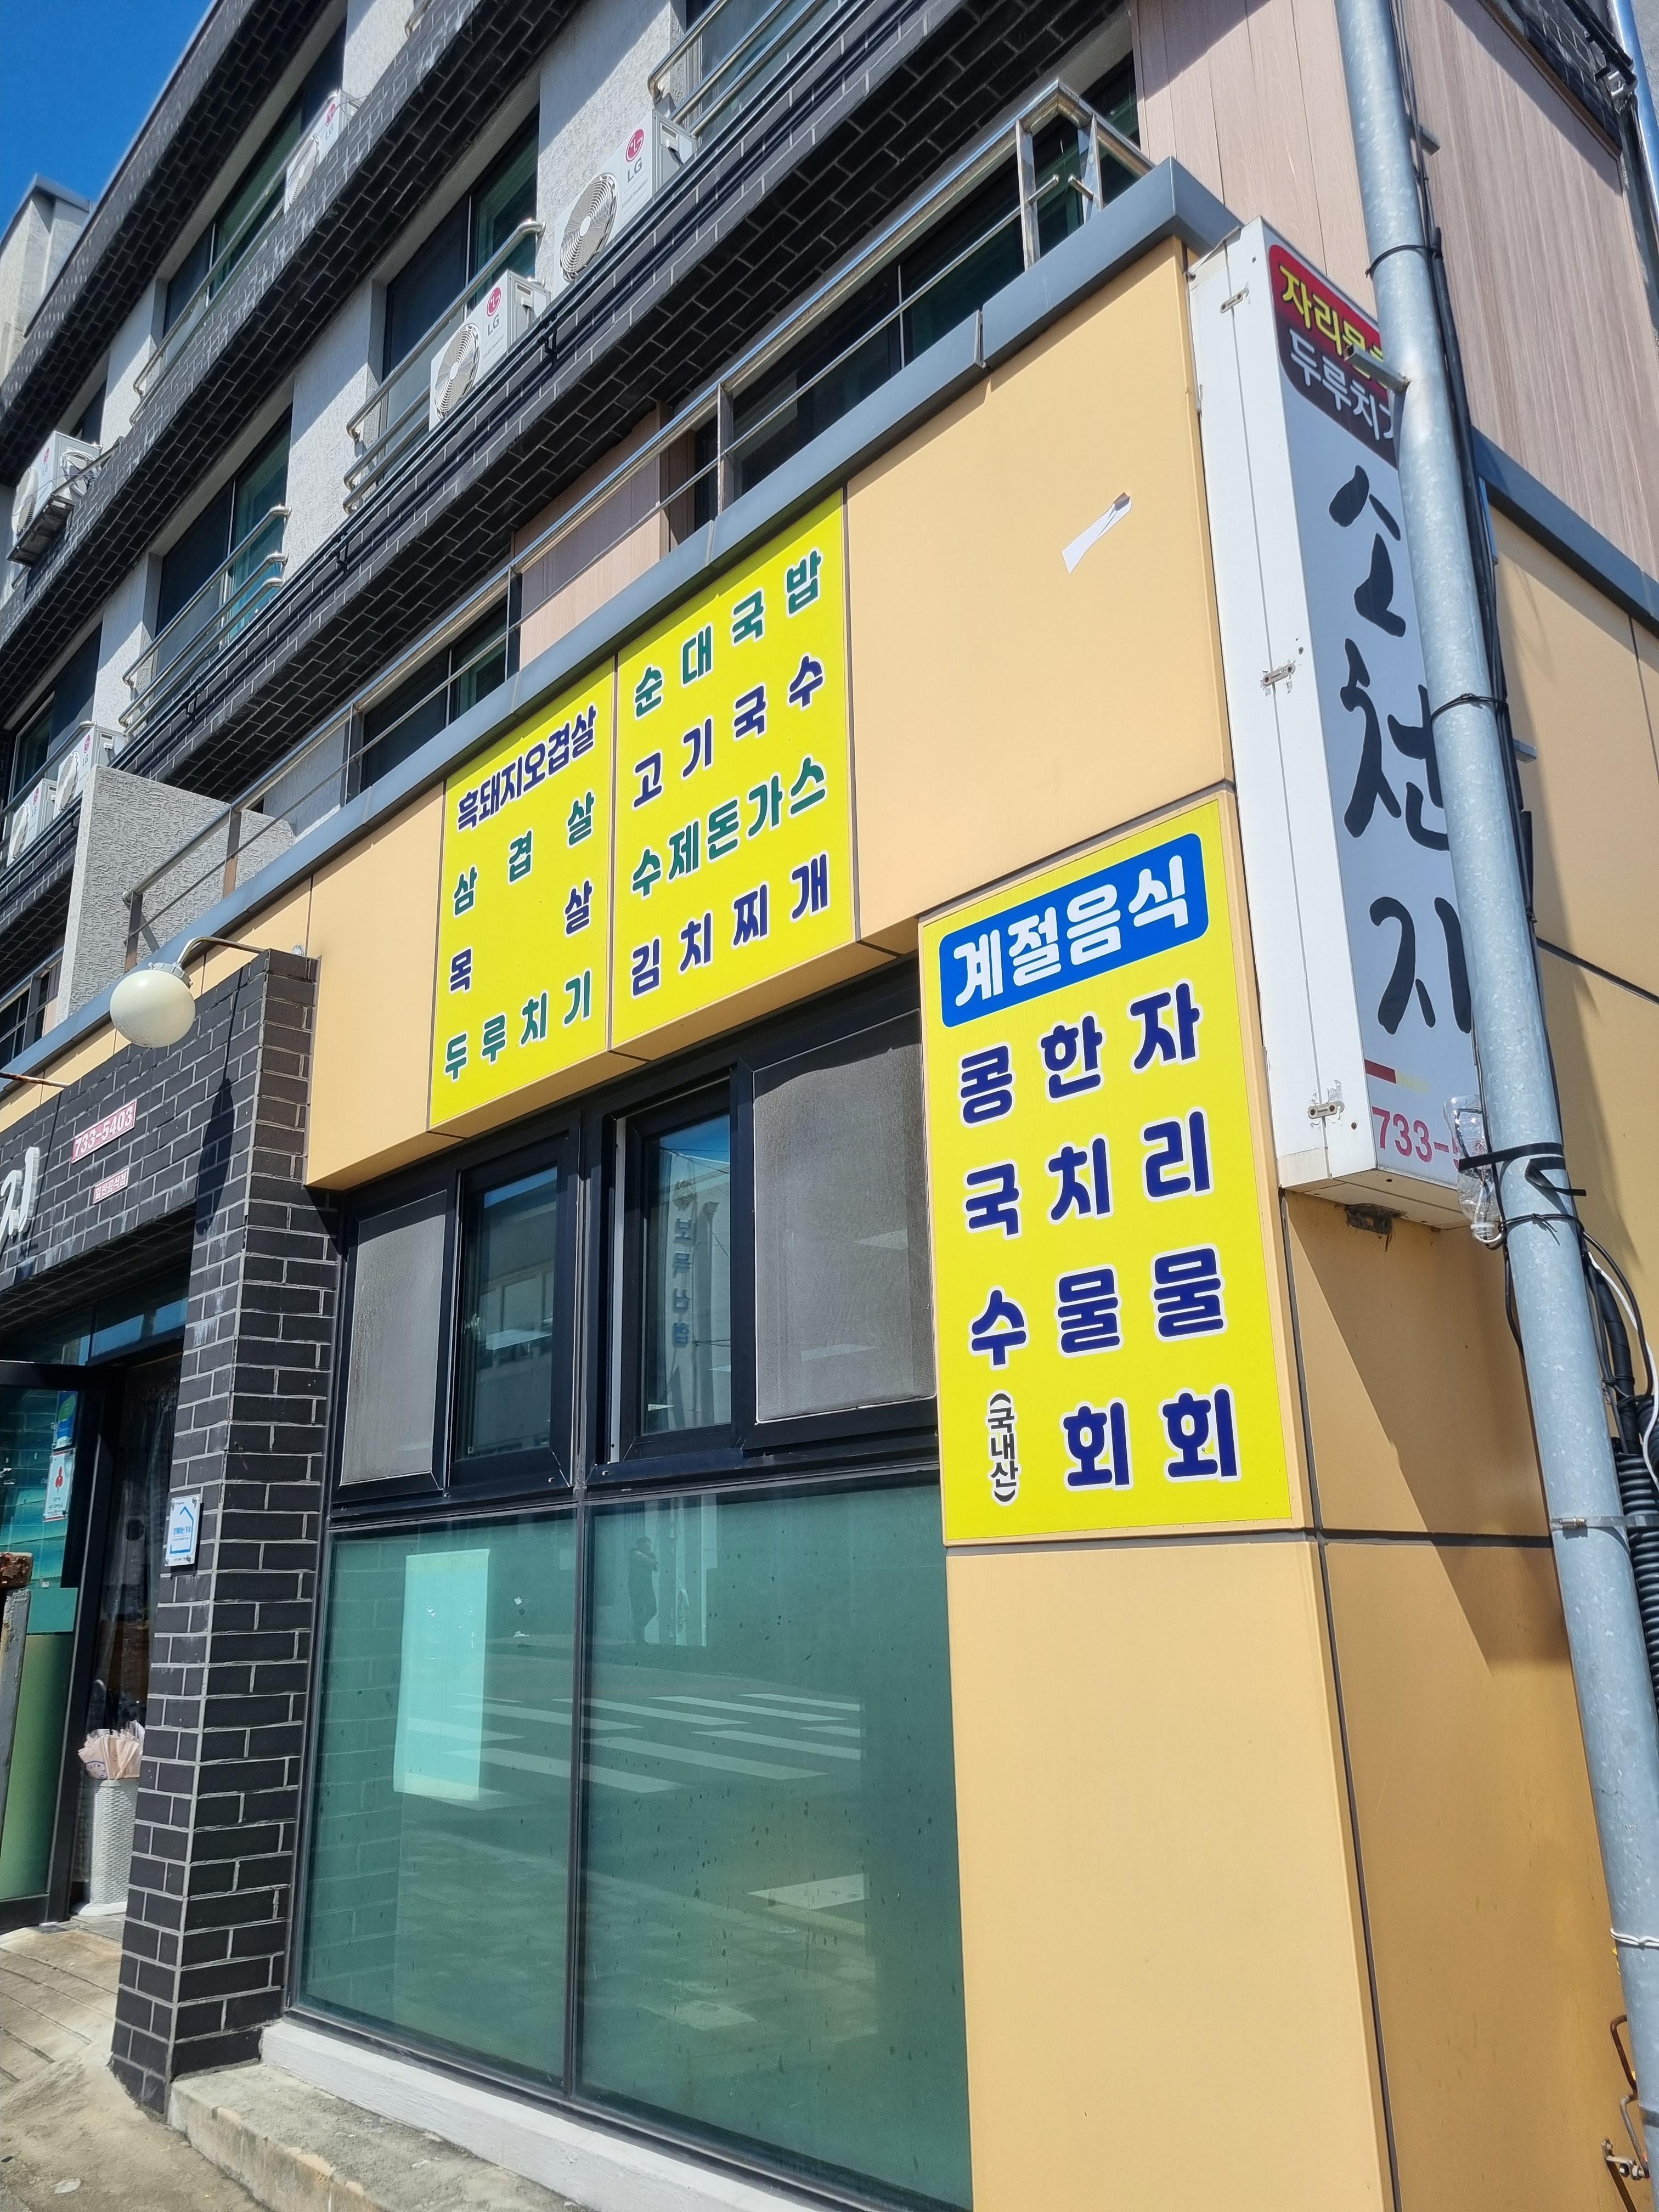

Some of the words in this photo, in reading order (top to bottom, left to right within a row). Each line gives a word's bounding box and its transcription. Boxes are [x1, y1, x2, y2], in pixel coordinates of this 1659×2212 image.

[627, 157, 642, 183] LG
[487, 314, 500, 336] LG
[635, 551, 821, 716] 순대국밥
[459, 706, 596, 830] 흑돼지오겹살
[634, 659, 822, 807] 고기국수
[633, 759, 825, 896] 수제돈가스
[632, 854, 827, 995] 김치찌개
[954, 856, 1188, 1006] 계절음식
[445, 971, 590, 1079] 두루치기
[75, 1106, 133, 1156] 733-5403
[95, 1171, 127, 1200] 일반음식점
[961, 1046, 1026, 1365] 콩국수
[1041, 1016, 1129, 1486] 한치물회
[1130, 983, 1237, 1477] 자리물회
[988, 1393, 1018, 1502] (국내산)
